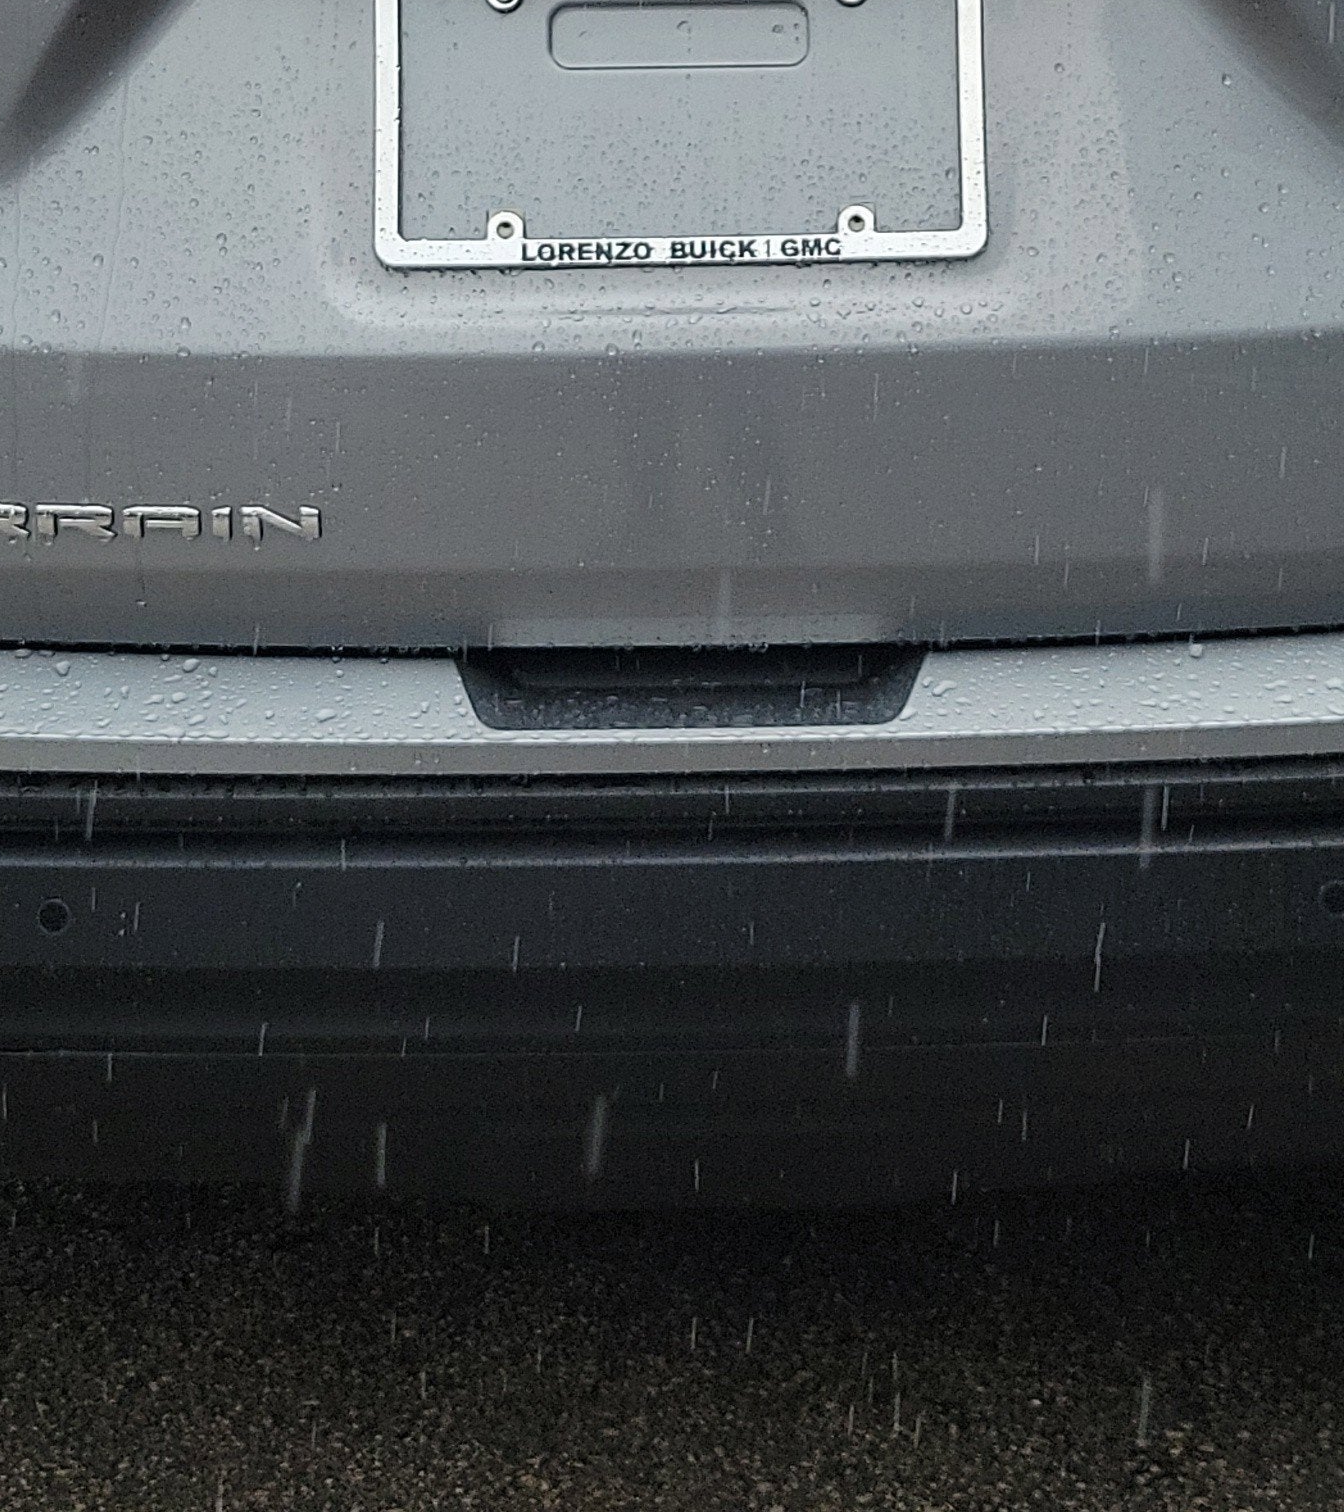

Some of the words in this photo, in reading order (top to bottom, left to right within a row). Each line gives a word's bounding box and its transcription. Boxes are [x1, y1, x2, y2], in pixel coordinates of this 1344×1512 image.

[521, 241, 654, 262] LORENZO
[669, 238, 758, 260] BUICK
[780, 237, 843, 258] GMC
